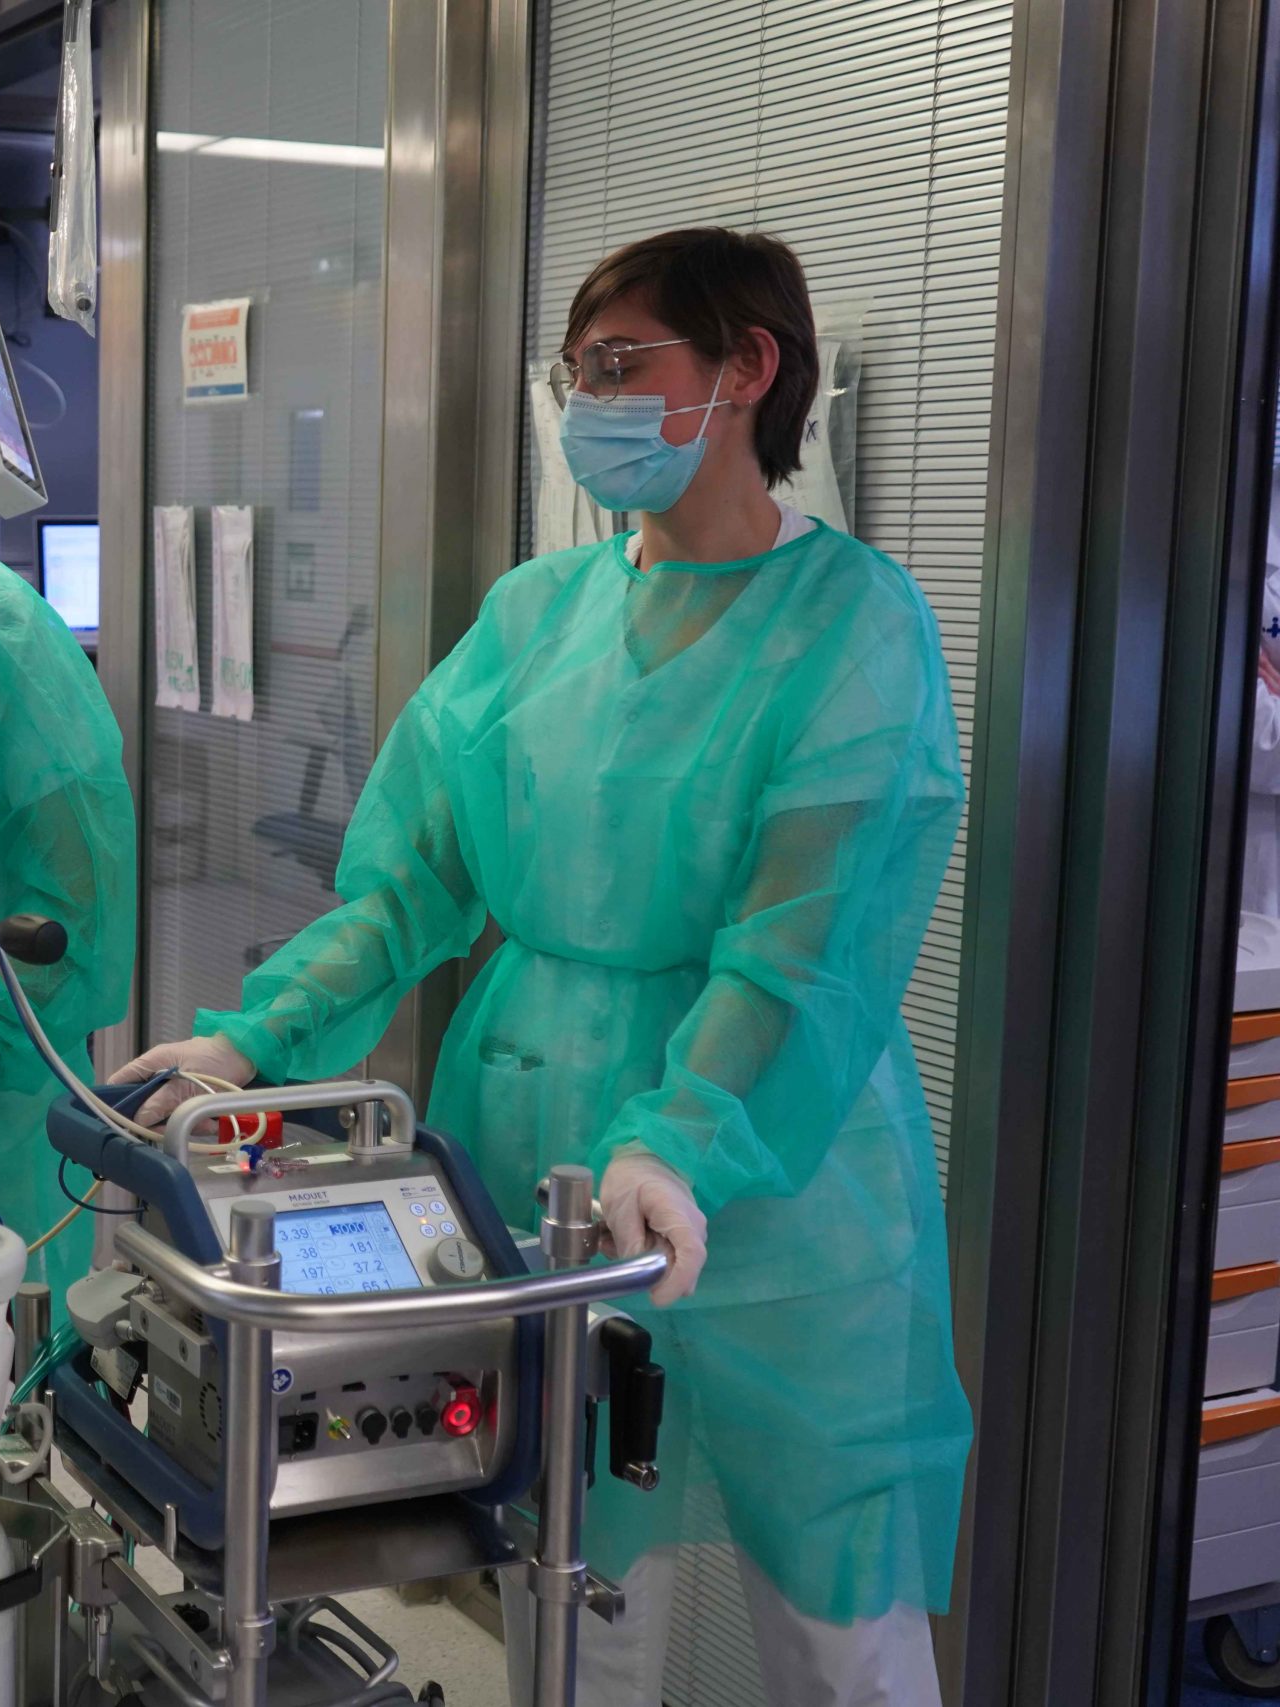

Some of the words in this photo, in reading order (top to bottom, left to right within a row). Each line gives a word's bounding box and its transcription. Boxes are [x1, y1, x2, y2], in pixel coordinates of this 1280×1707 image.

[278, 1227, 310, 1242] 3.39
[330, 1221, 366, 1236] 3000
[295, 1246, 318, 1260] -38
[349, 1240, 374, 1254] 181
[301, 1266, 325, 1280] 197
[352, 1259, 385, 1274] 37.2
